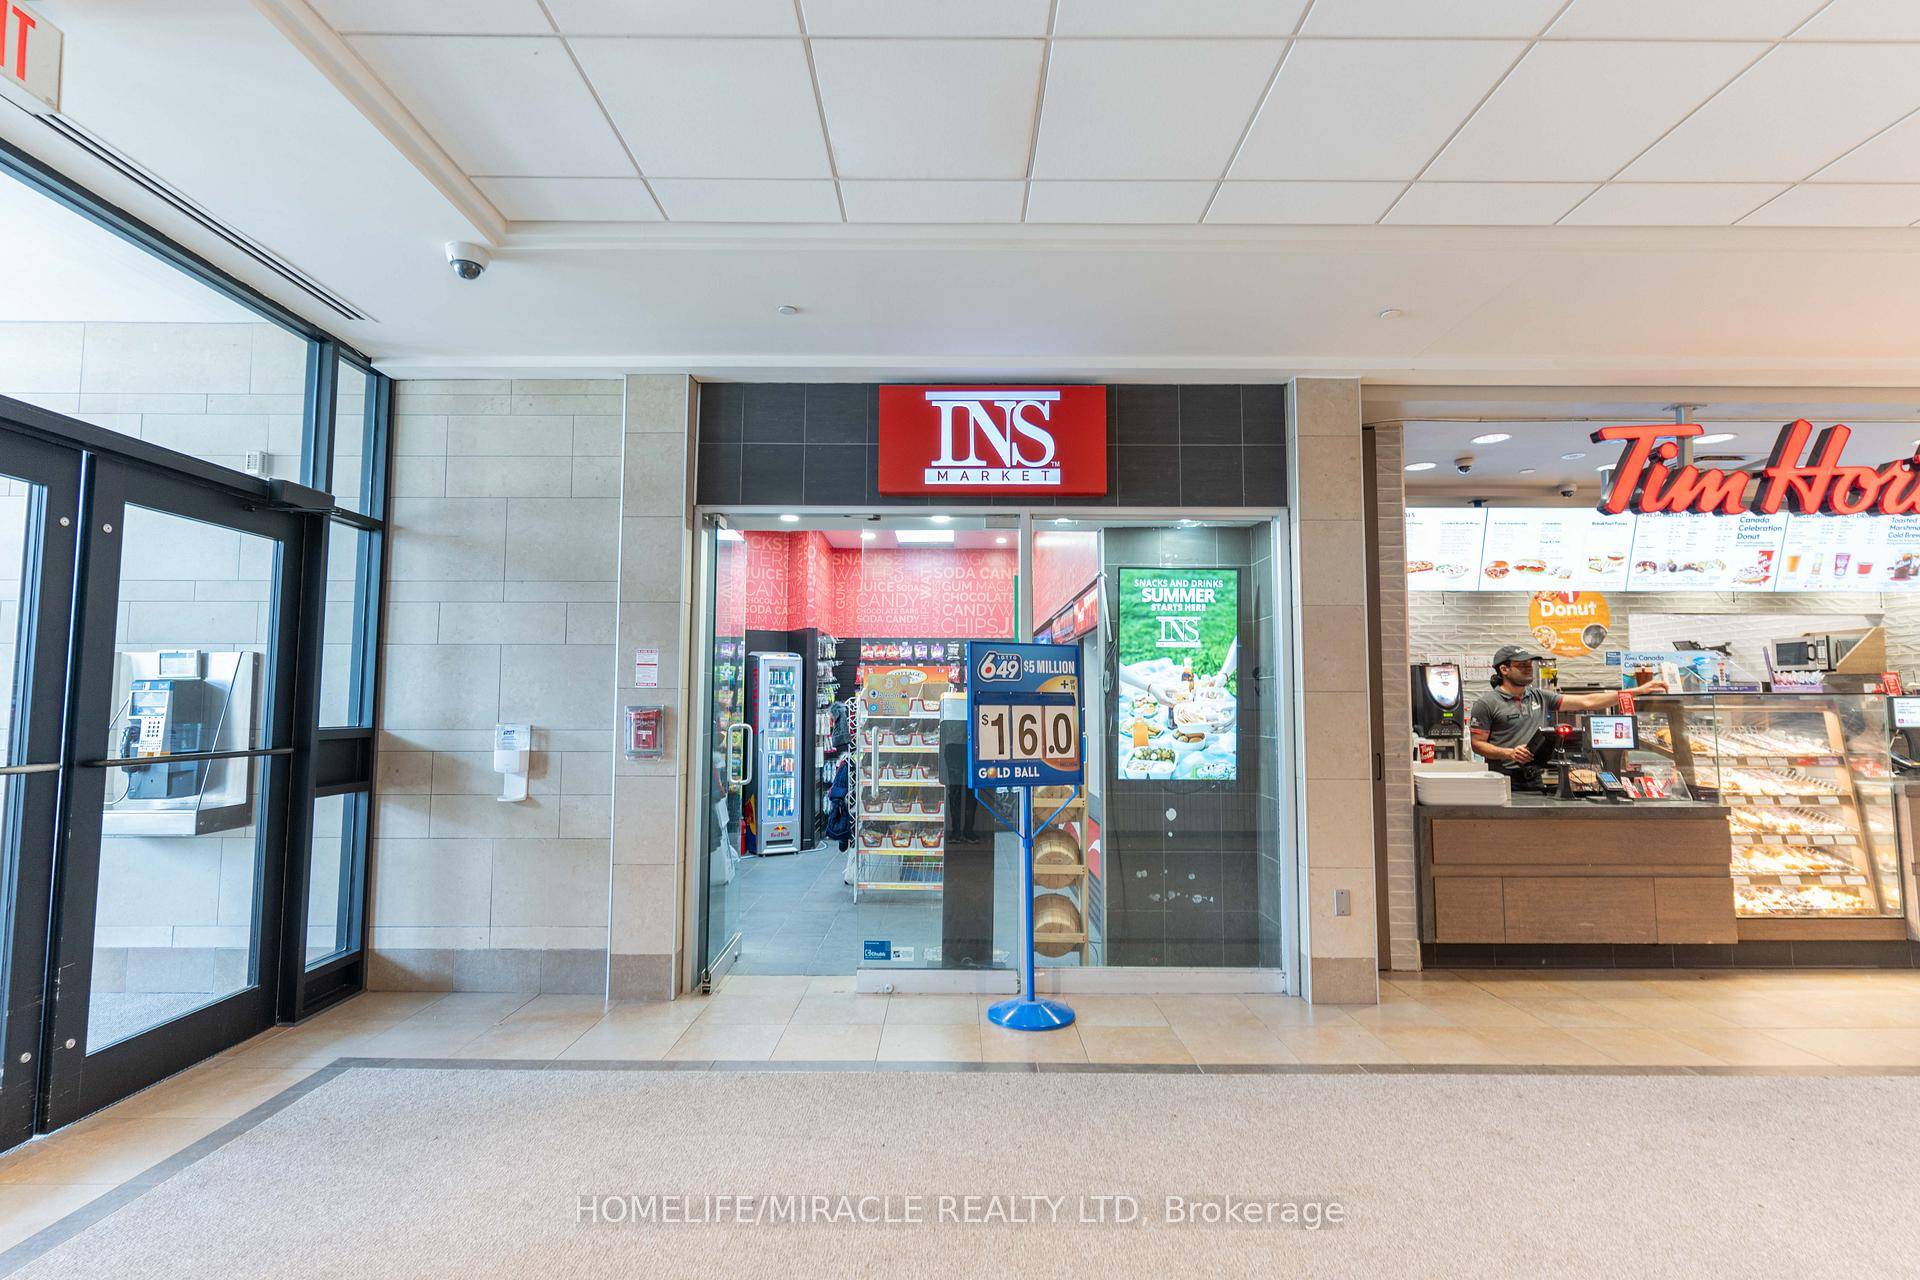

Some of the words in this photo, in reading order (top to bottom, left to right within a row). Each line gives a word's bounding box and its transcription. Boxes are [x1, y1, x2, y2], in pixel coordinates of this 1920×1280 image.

[931, 400, 1055, 468] INS
[1592, 423, 1750, 518] Tim
[1752, 418, 1920, 518] Hor
[937, 470, 1050, 481] MARKET
[1739, 516, 1770, 524] Canada
[934, 567, 976, 580] SODA
[942, 581, 972, 592] GUM
[1134, 579, 1168, 588] SNACKS
[1171, 579, 1189, 588] AND
[1191, 579, 1223, 588] DRINKS
[856, 592, 920, 608] CANDY
[1142, 588, 1216, 603] SUMMER
[943, 603, 997, 617] CANDY
[1151, 604, 1182, 612] STARTS
[1185, 604, 1206, 612] HERE
[1541, 601, 1597, 617] Donut
[1158, 619, 1200, 642] INS
[1023, 660, 1035, 673] $5
[1037, 660, 1075, 674] MILLION
[1014, 767, 1040, 778] BALL
